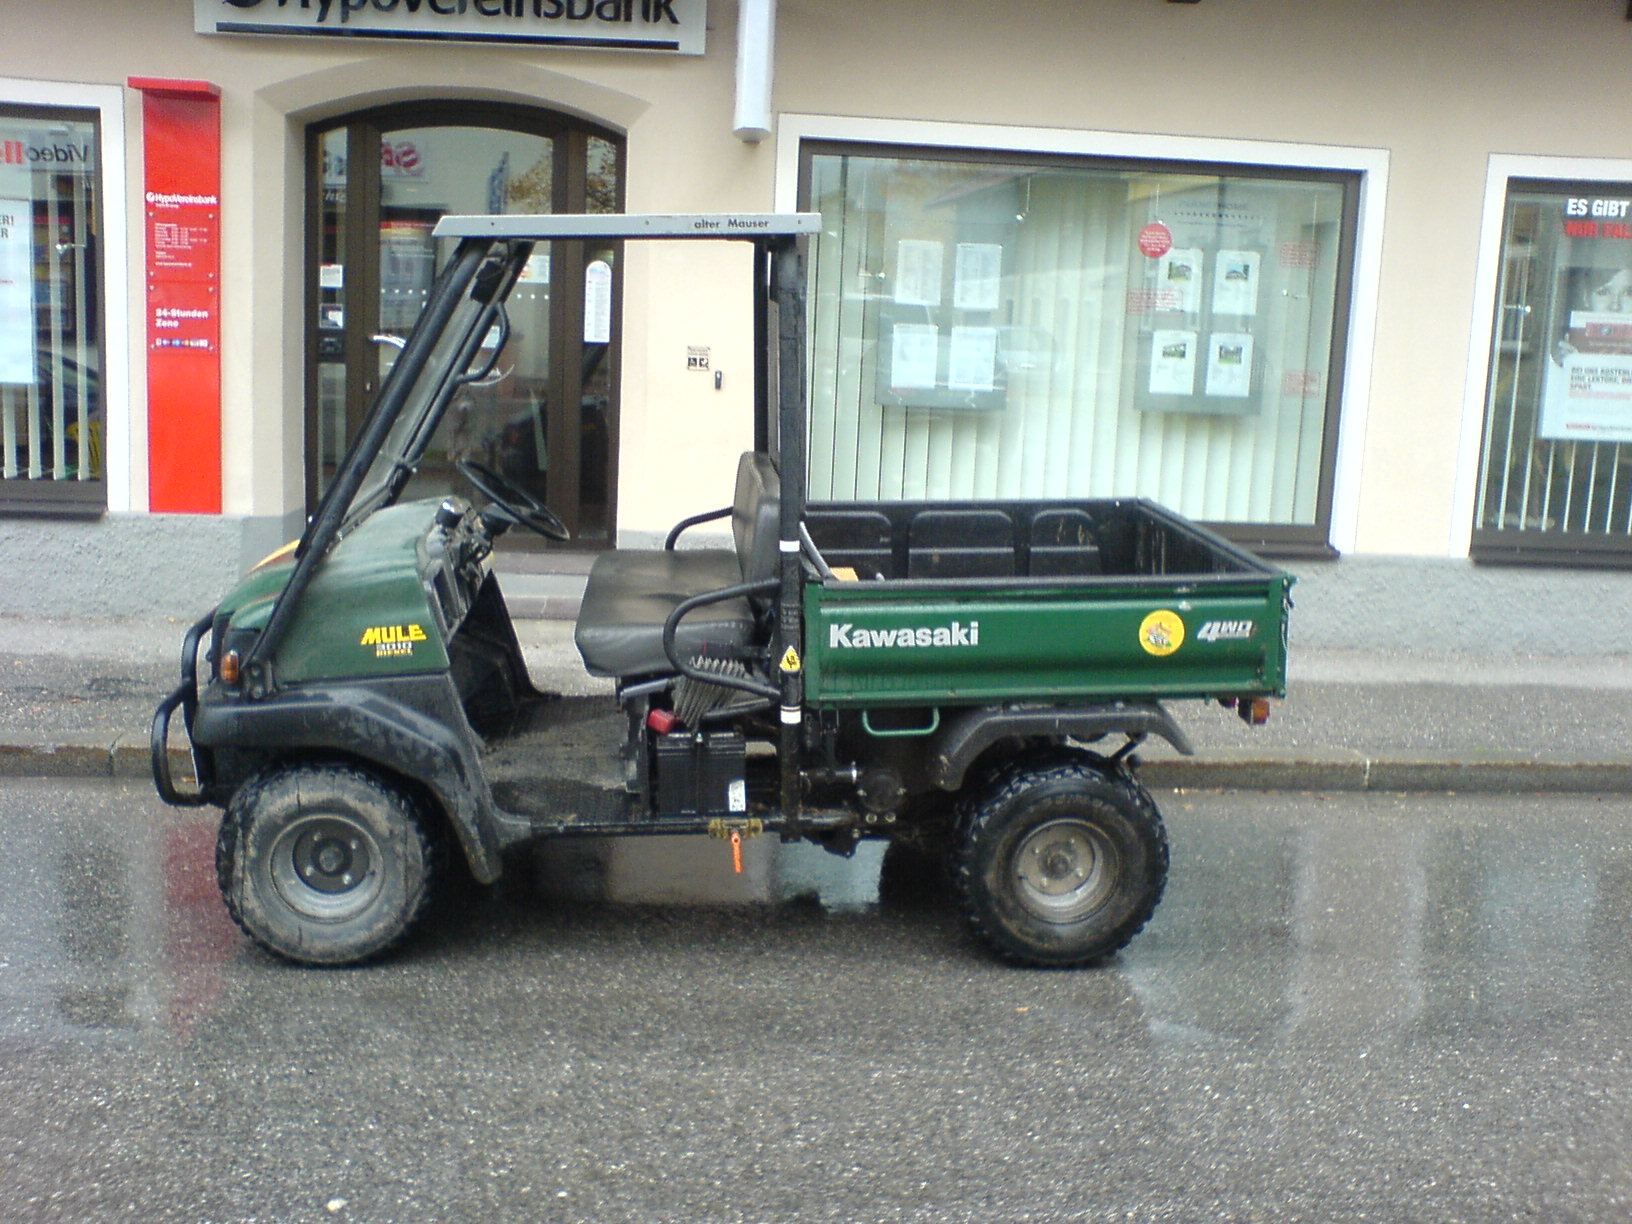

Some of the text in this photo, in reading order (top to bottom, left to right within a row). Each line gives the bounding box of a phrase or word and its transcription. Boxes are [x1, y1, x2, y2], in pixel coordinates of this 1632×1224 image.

[1567, 198, 1630, 217] ES GIBT
[694, 217, 769, 229] alter Mauser
[361, 624, 427, 646] MULE
[829, 621, 979, 648] Kawasaki
